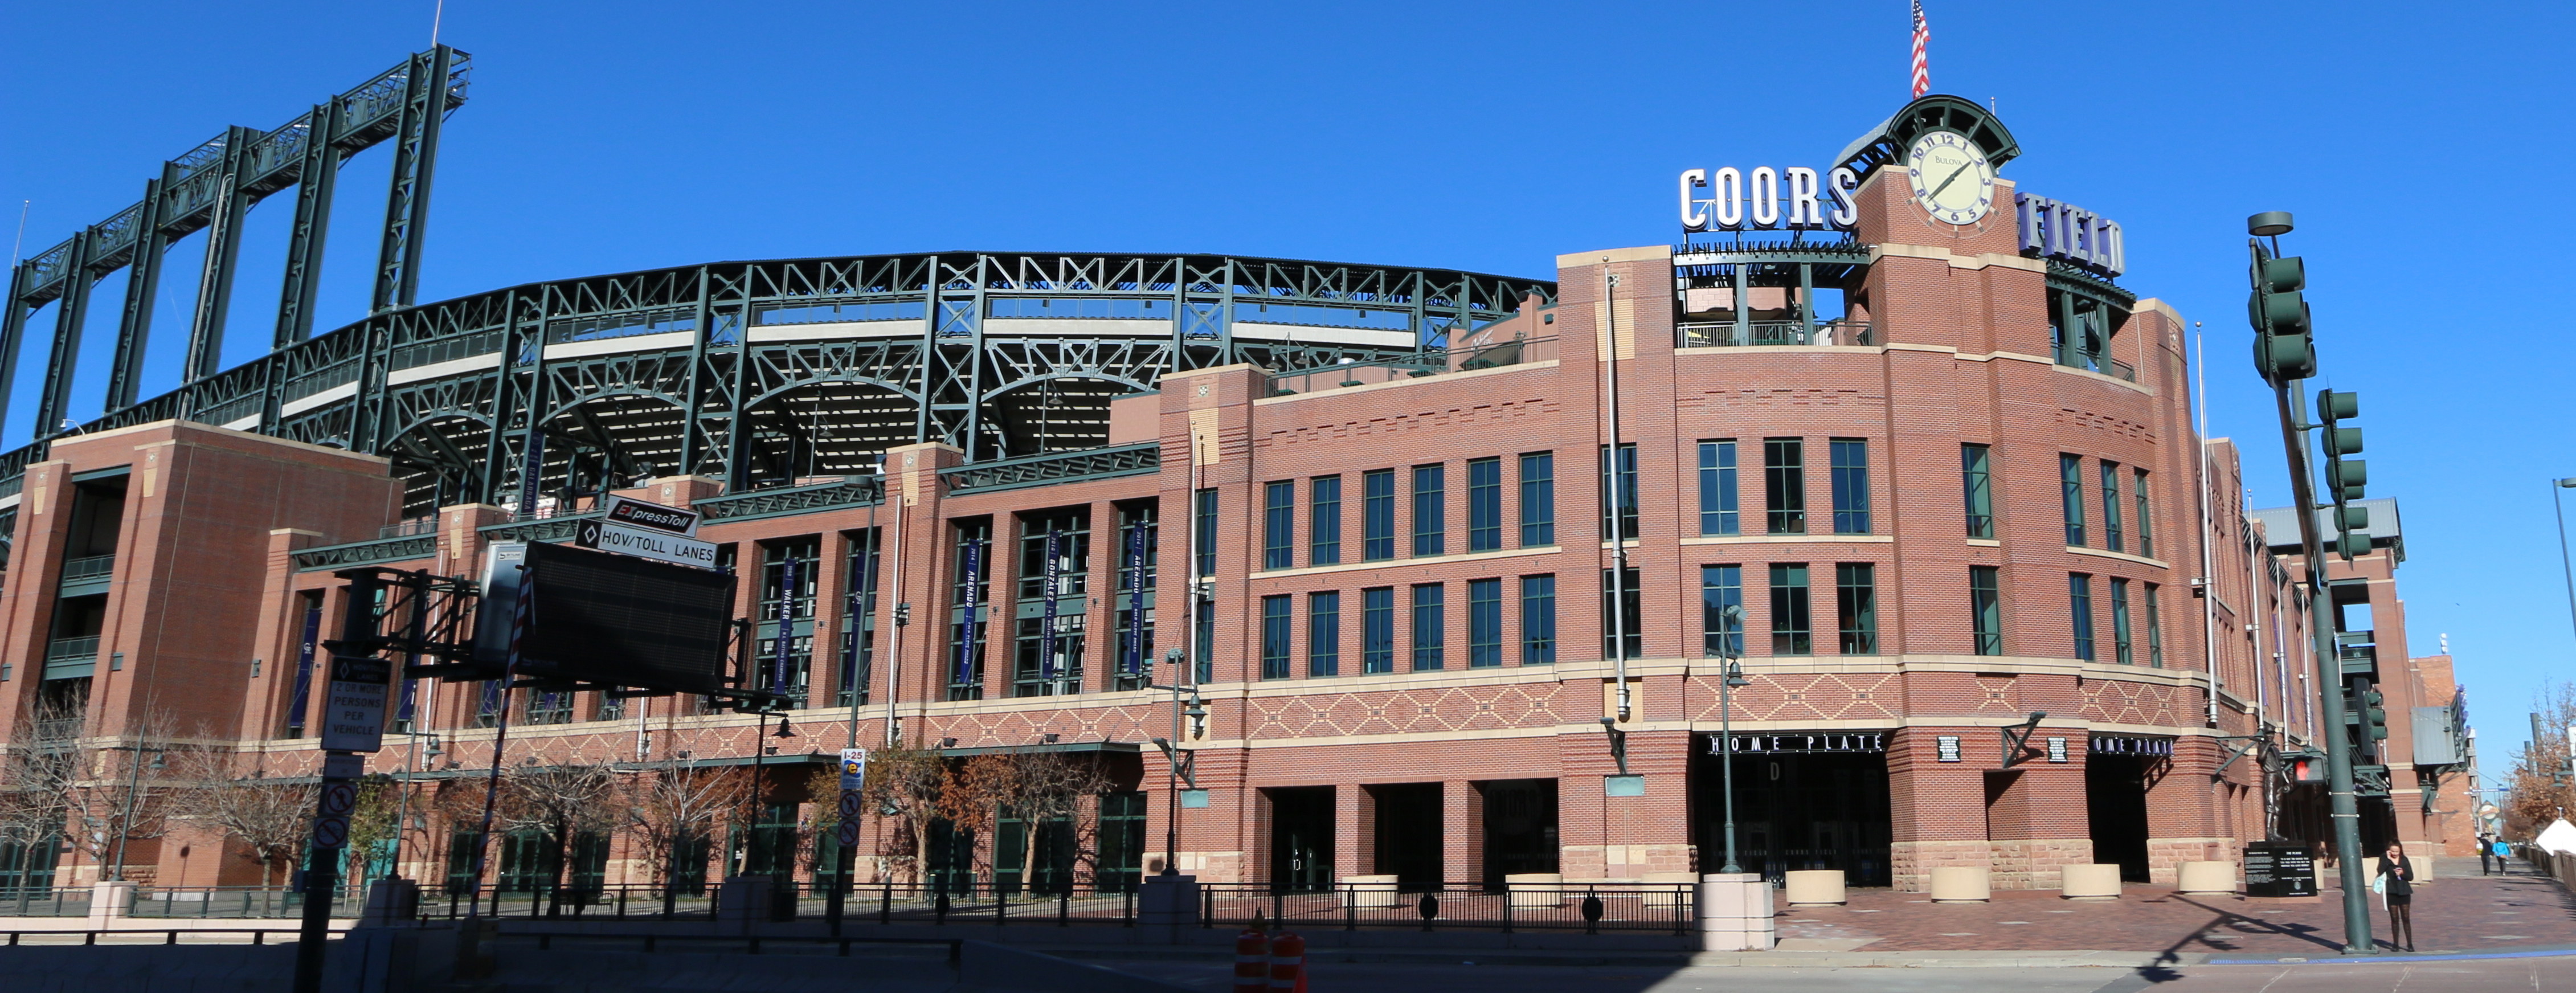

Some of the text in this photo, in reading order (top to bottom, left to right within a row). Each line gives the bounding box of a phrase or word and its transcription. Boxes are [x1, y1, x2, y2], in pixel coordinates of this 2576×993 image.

[1924, 137, 1935, 147] 11
[1940, 134, 1954, 144] 12
[1963, 141, 1968, 150] 1
[1912, 147, 1924, 160] 10
[1935, 155, 1963, 166] BULOVA
[1975, 158, 1984, 167] 2
[1911, 168, 1920, 177] 9
[1680, 166, 1857, 229] COORS
[1917, 189, 1926, 198] 8
[1980, 197, 1989, 207] 4
[1931, 204, 1941, 213] 7
[1968, 209, 1977, 219] 5
[1951, 212, 1959, 222] 6
[2015, 192, 2125, 276] FIELD
[524, 467, 535, 510] GALARRAGA
[602, 530, 713, 561] HOV/TOLL LANES
[1047, 559, 1056, 602] GONZALEZ
[966, 570, 975, 607] ARENADO
[782, 589, 791, 620] WALKER
[336, 683, 382, 694] 2 OR MORE
[334, 696, 381, 708] PERSONS
[344, 711, 363, 721] PER
[333, 725, 374, 735] VEHICLE
[1712, 735, 1880, 751] HOME PLATE
[2088, 738, 2174, 755] OME PLATE
[1771, 762, 1780, 780] D
